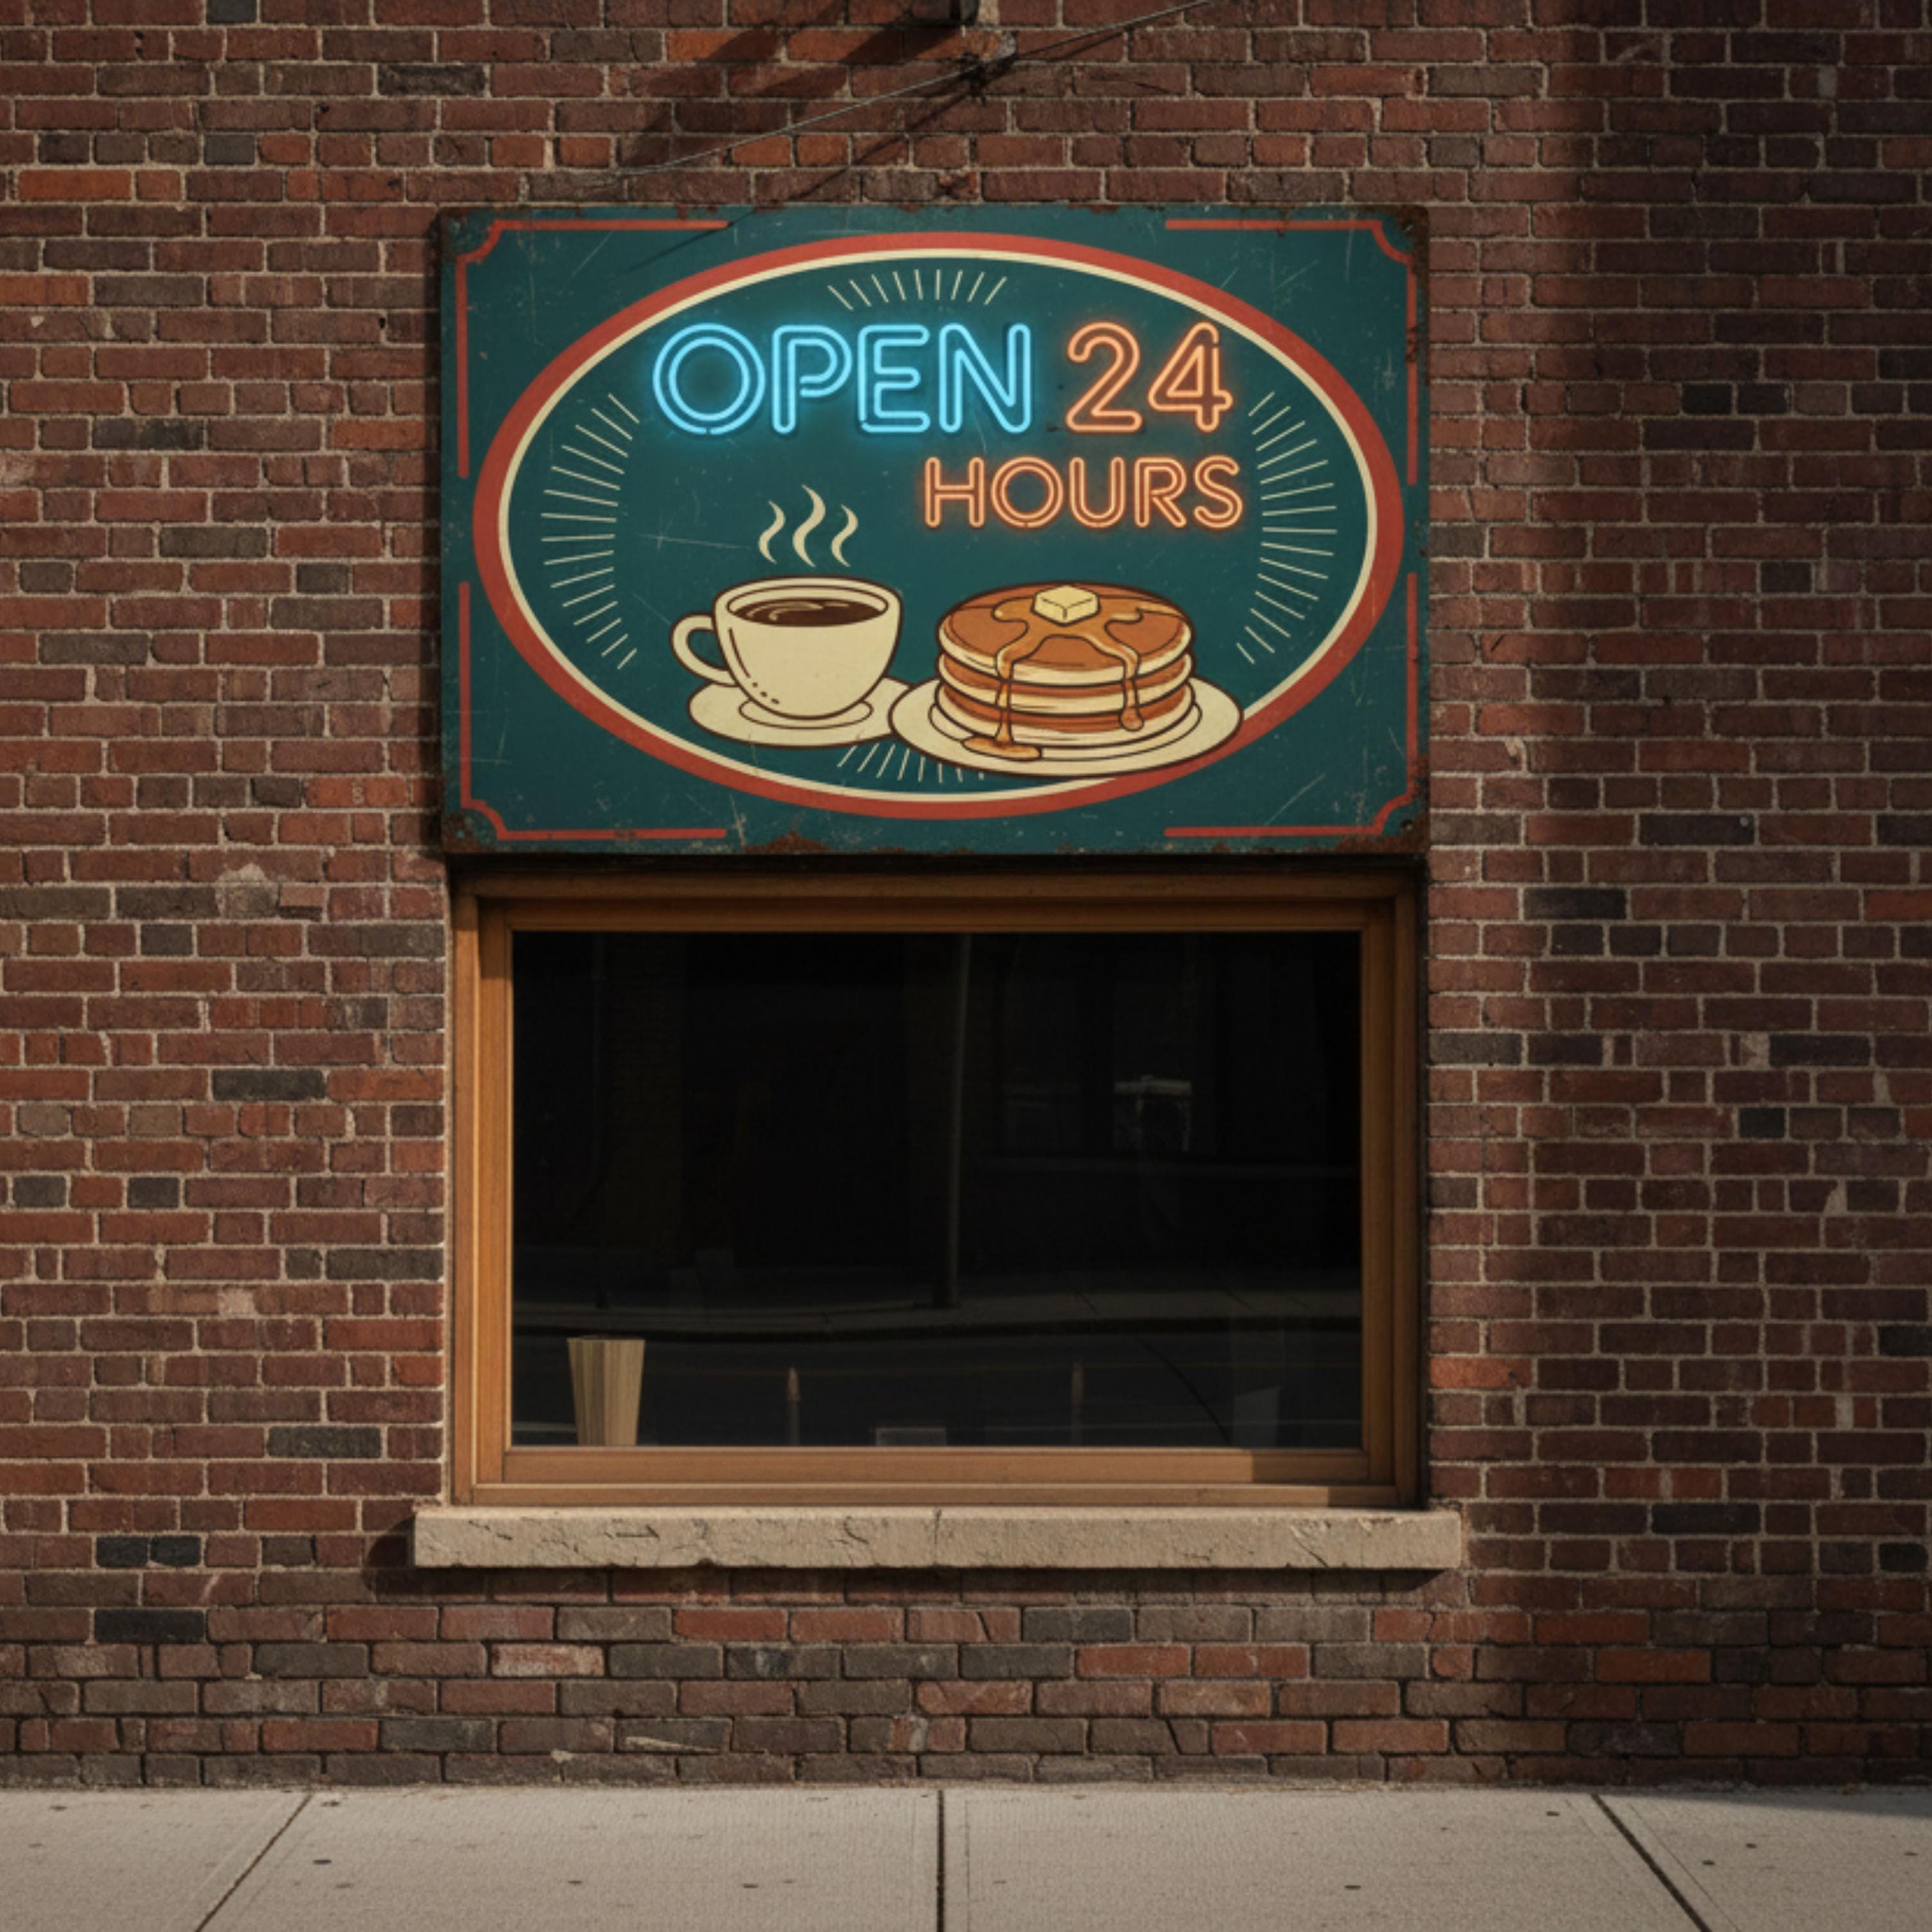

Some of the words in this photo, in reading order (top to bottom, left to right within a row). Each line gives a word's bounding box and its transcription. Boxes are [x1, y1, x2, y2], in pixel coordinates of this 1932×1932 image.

[653, 323, 1031, 434] OPEN
[1066, 322, 1233, 433] 24
[925, 457, 1243, 529] HOURS
